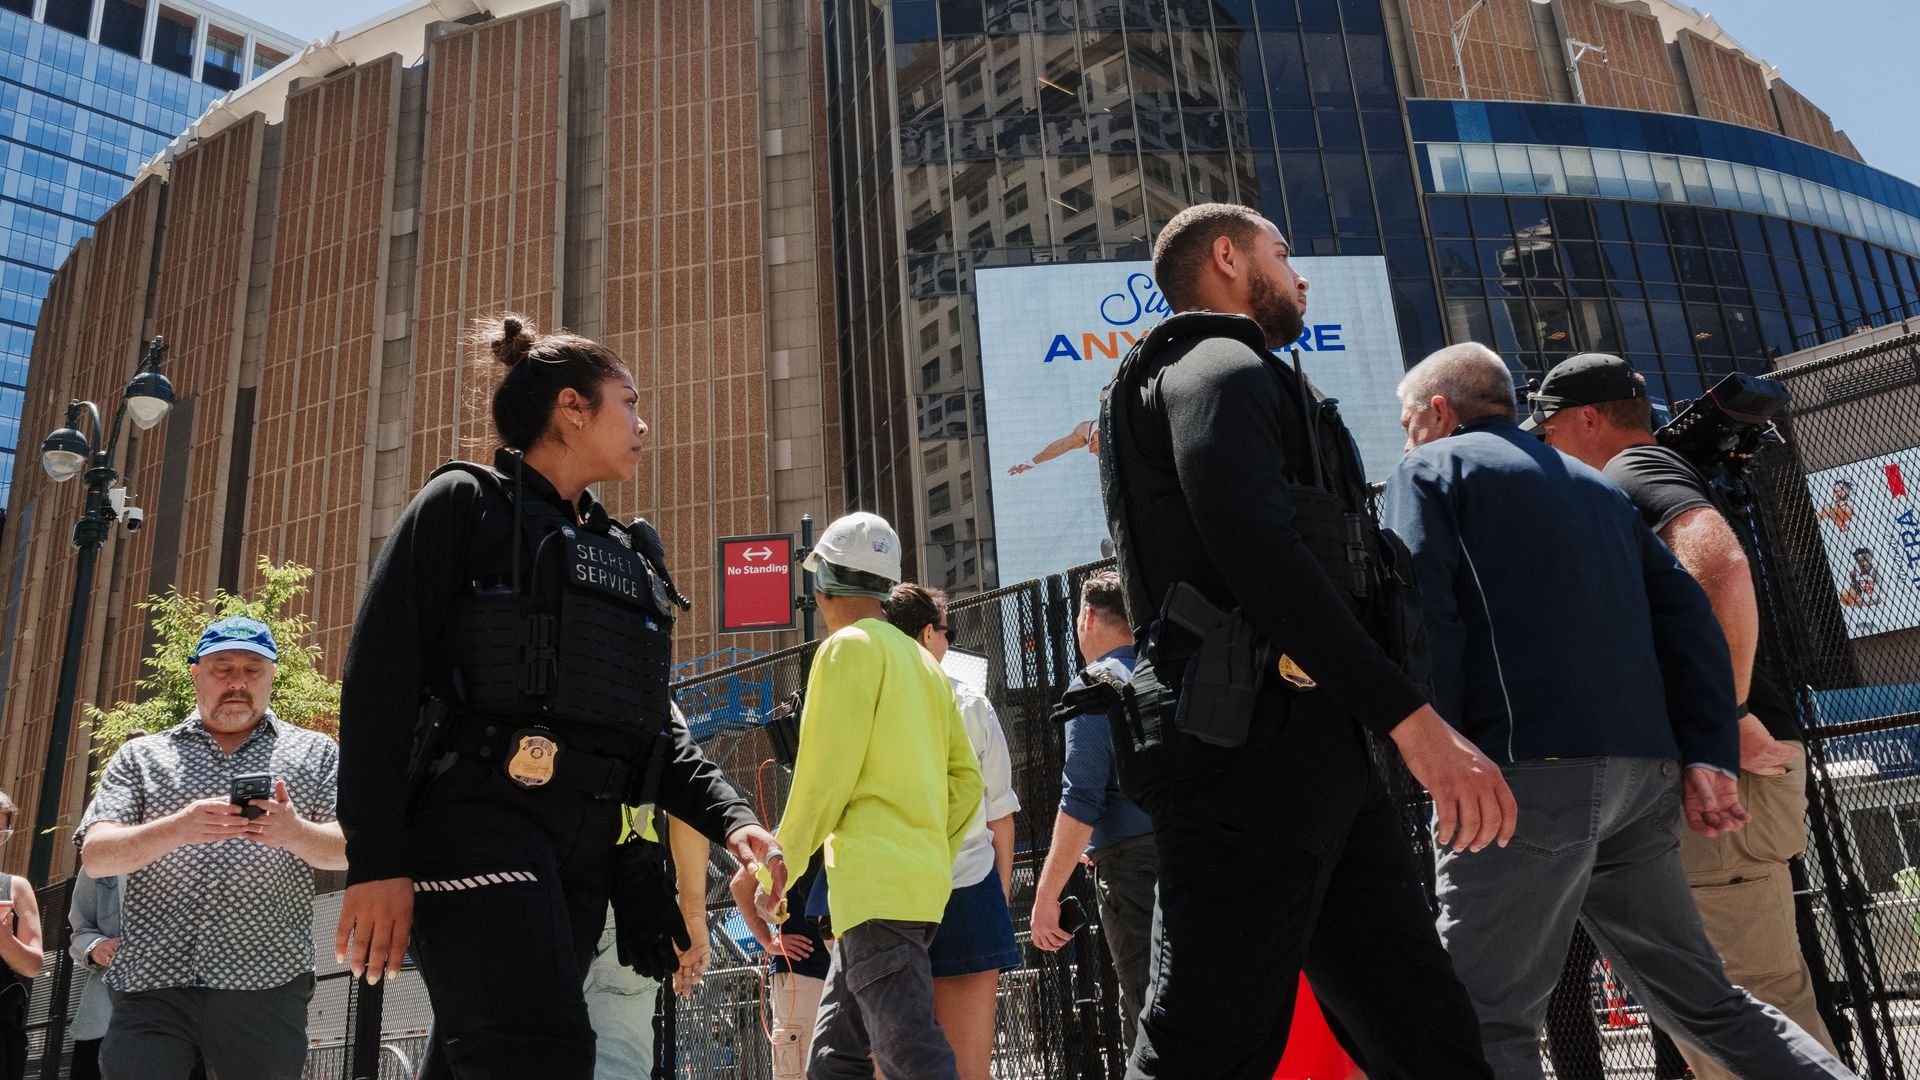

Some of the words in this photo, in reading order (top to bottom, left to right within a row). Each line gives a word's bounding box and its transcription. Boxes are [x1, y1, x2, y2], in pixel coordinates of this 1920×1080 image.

[576, 544, 633, 574] SECRET
[727, 566, 742, 575] No
[743, 564, 788, 575] Standing
[576, 564, 639, 598] SERVICE
